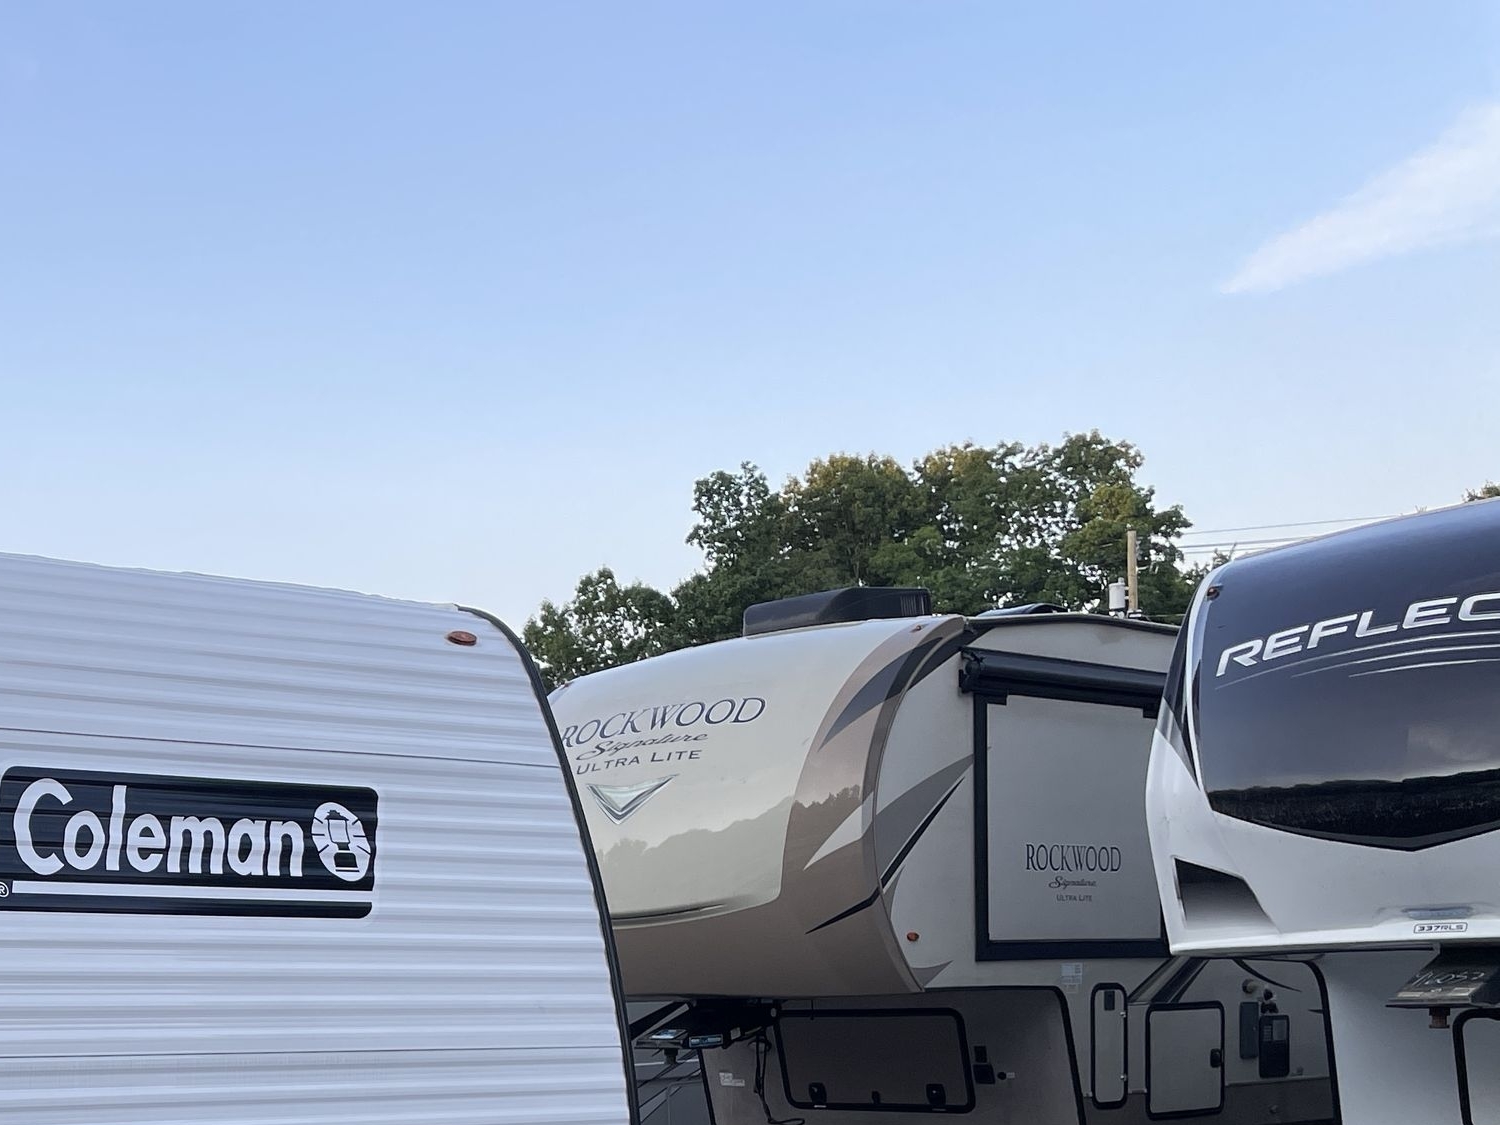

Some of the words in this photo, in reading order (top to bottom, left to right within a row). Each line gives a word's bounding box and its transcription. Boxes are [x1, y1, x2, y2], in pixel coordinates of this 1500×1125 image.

[562, 697, 766, 748] ROCKWOOD
[576, 733, 708, 761] Signature
[576, 757, 640, 775] ULTRA
[650, 750, 702, 763] LITE
[12, 777, 305, 876] Coleman
[1025, 843, 1122, 873] ROCKWOOD
[1417, 923, 1464, 932] 337RLS
